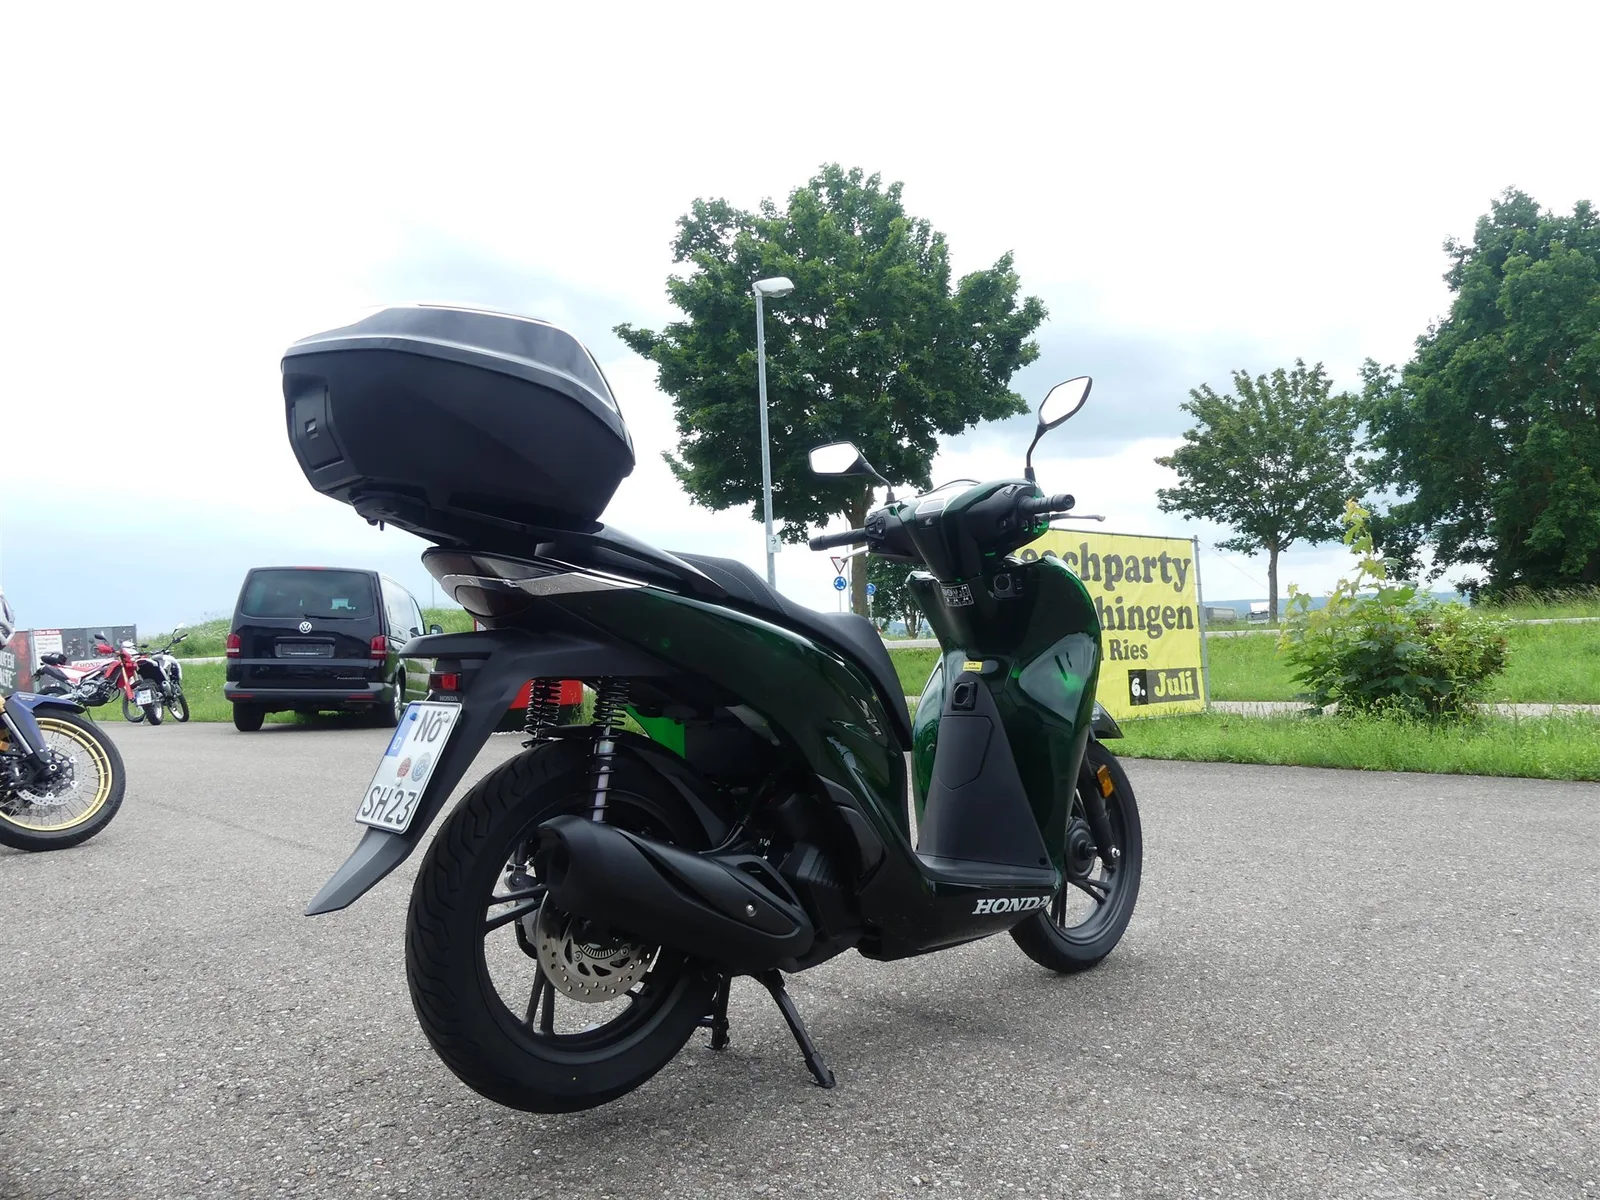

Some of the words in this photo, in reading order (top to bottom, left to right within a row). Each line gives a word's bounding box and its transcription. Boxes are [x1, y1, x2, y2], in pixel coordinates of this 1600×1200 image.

[1007, 542, 1191, 592] chparty
[1094, 595, 1194, 639] hingen
[1109, 638, 1149, 661] Ries
[1131, 677, 1146, 697] 6.
[1154, 671, 1194, 697] Juli
[972, 895, 1051, 915] HONDA
